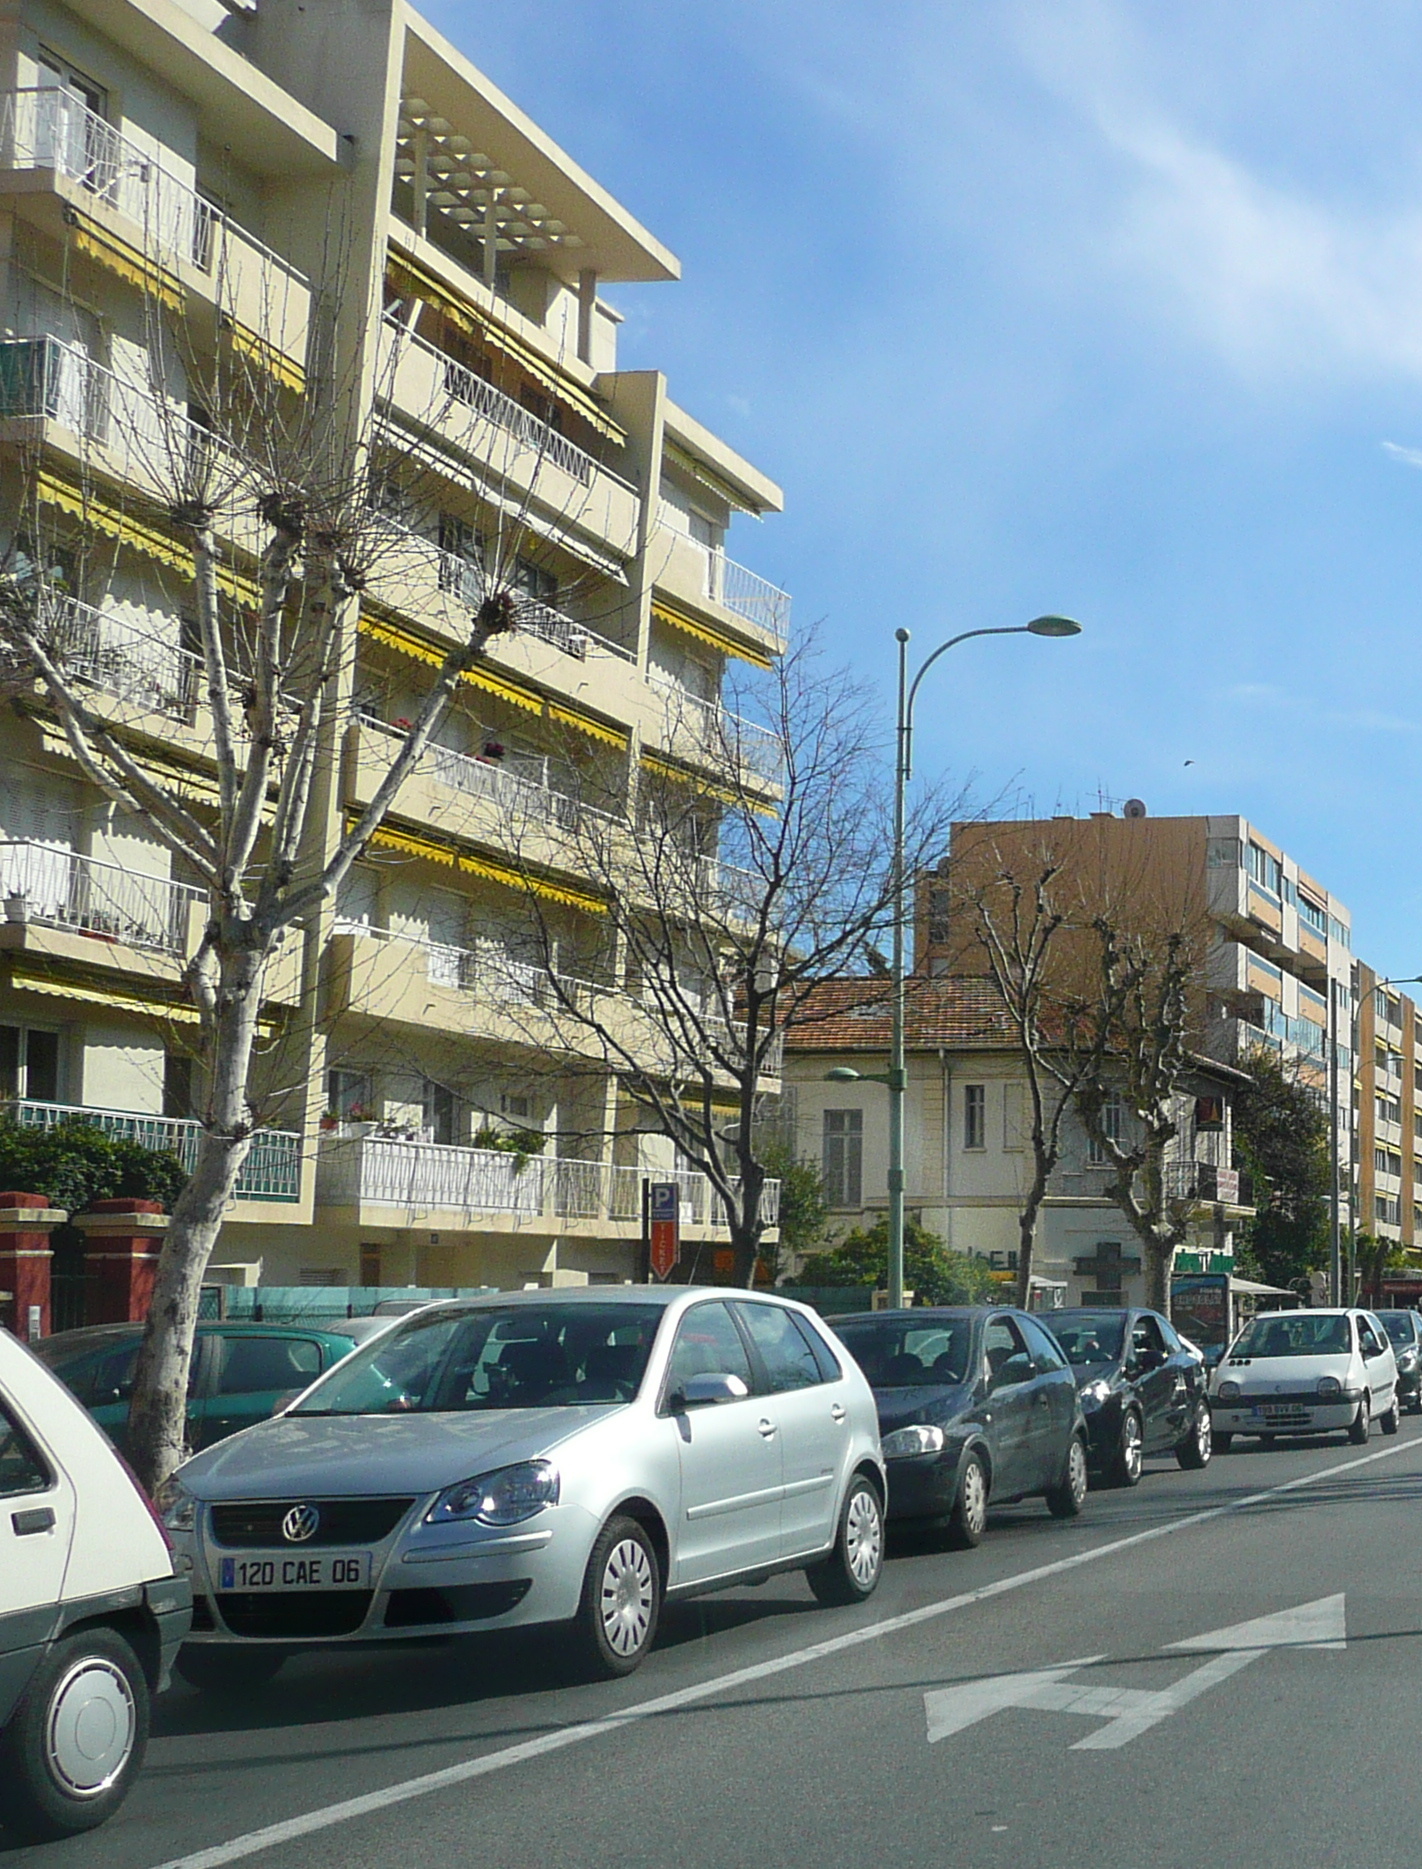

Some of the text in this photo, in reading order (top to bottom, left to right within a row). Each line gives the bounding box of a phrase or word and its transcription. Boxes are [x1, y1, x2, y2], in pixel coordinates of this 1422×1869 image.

[238, 1559, 360, 1586] 120 CAE 06
